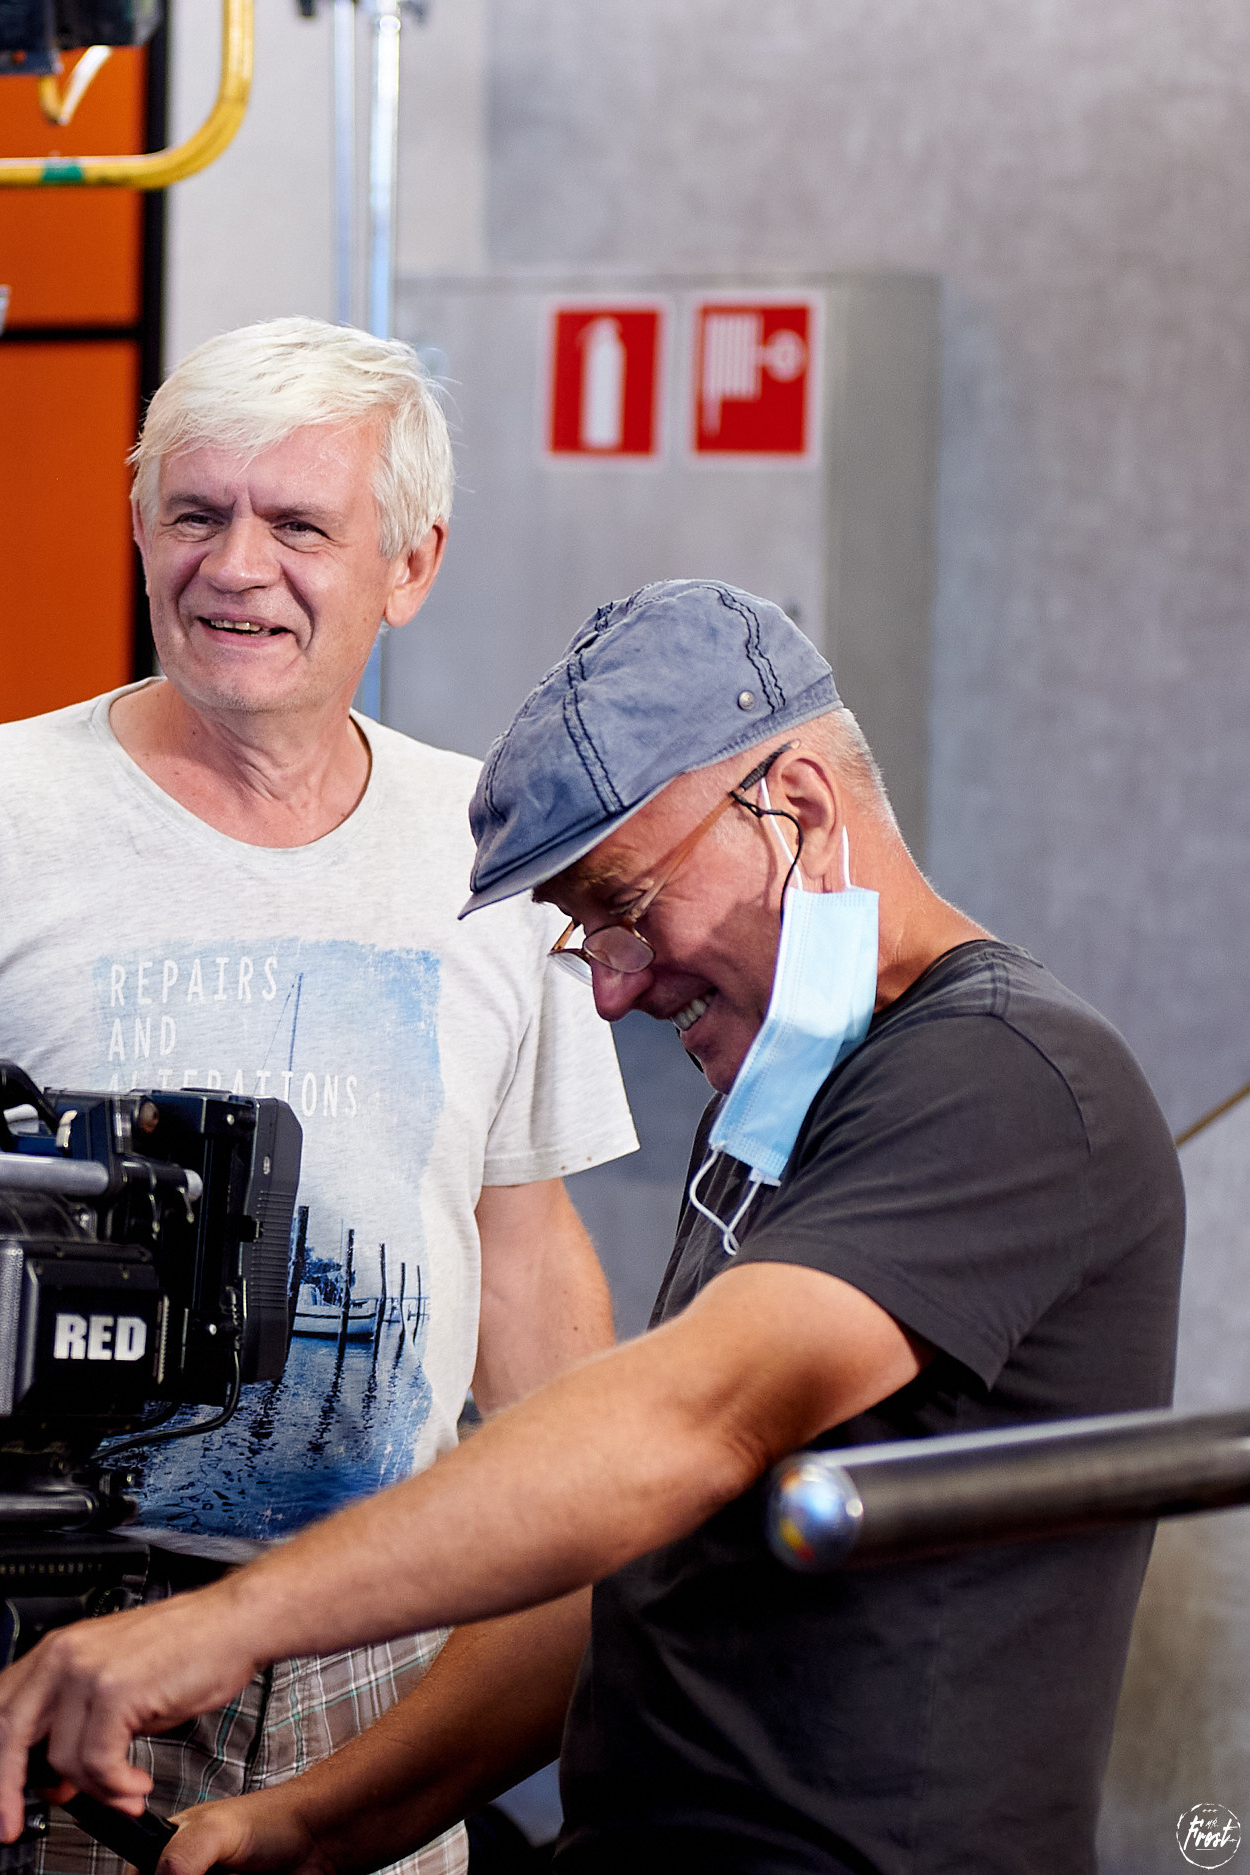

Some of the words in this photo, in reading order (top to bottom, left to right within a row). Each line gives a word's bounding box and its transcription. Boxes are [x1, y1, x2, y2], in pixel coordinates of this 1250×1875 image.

[110, 956, 278, 1008] REPAIRS
[108, 1015, 177, 1062] AND
[53, 1313, 147, 1361] RED
